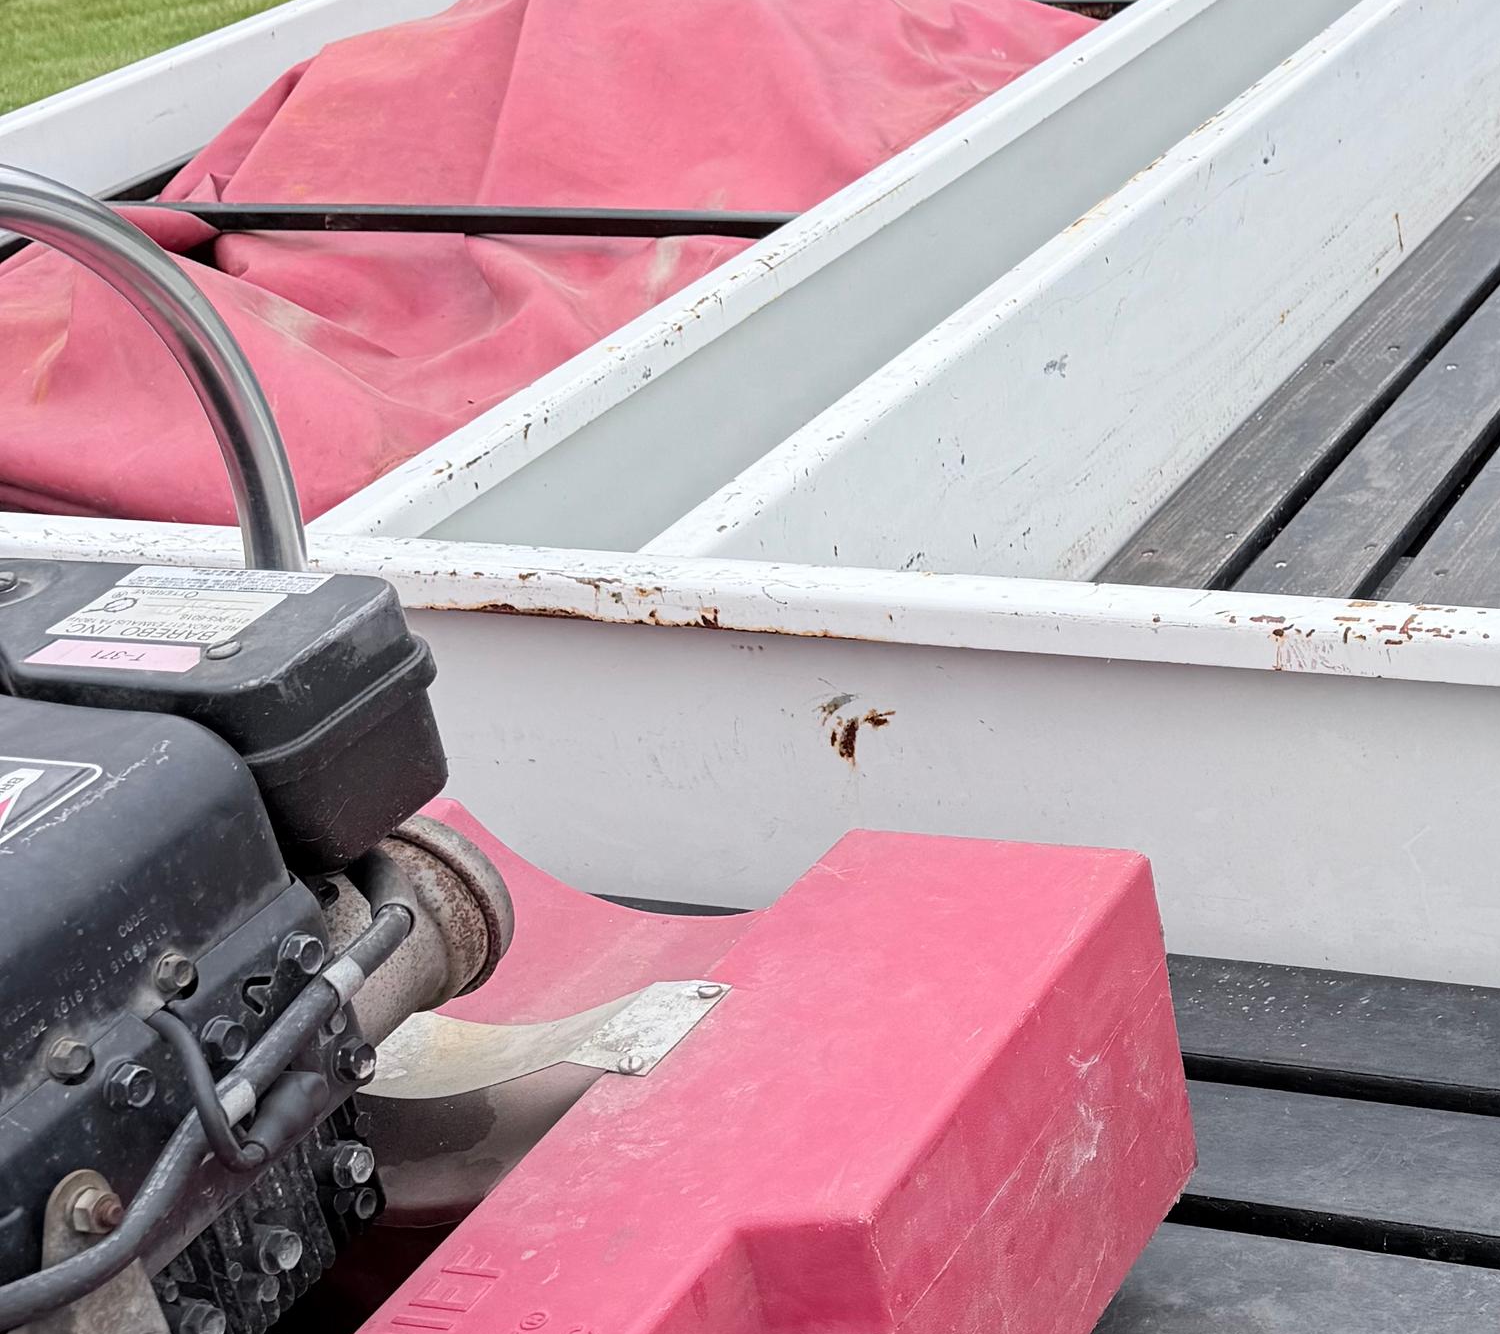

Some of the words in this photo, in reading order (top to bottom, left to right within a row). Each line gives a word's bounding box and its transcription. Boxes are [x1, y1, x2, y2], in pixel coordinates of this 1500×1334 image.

[119, 626, 218, 641] BAREBO
[89, 650, 147, 662] T-371
[117, 906, 149, 938] CODE
